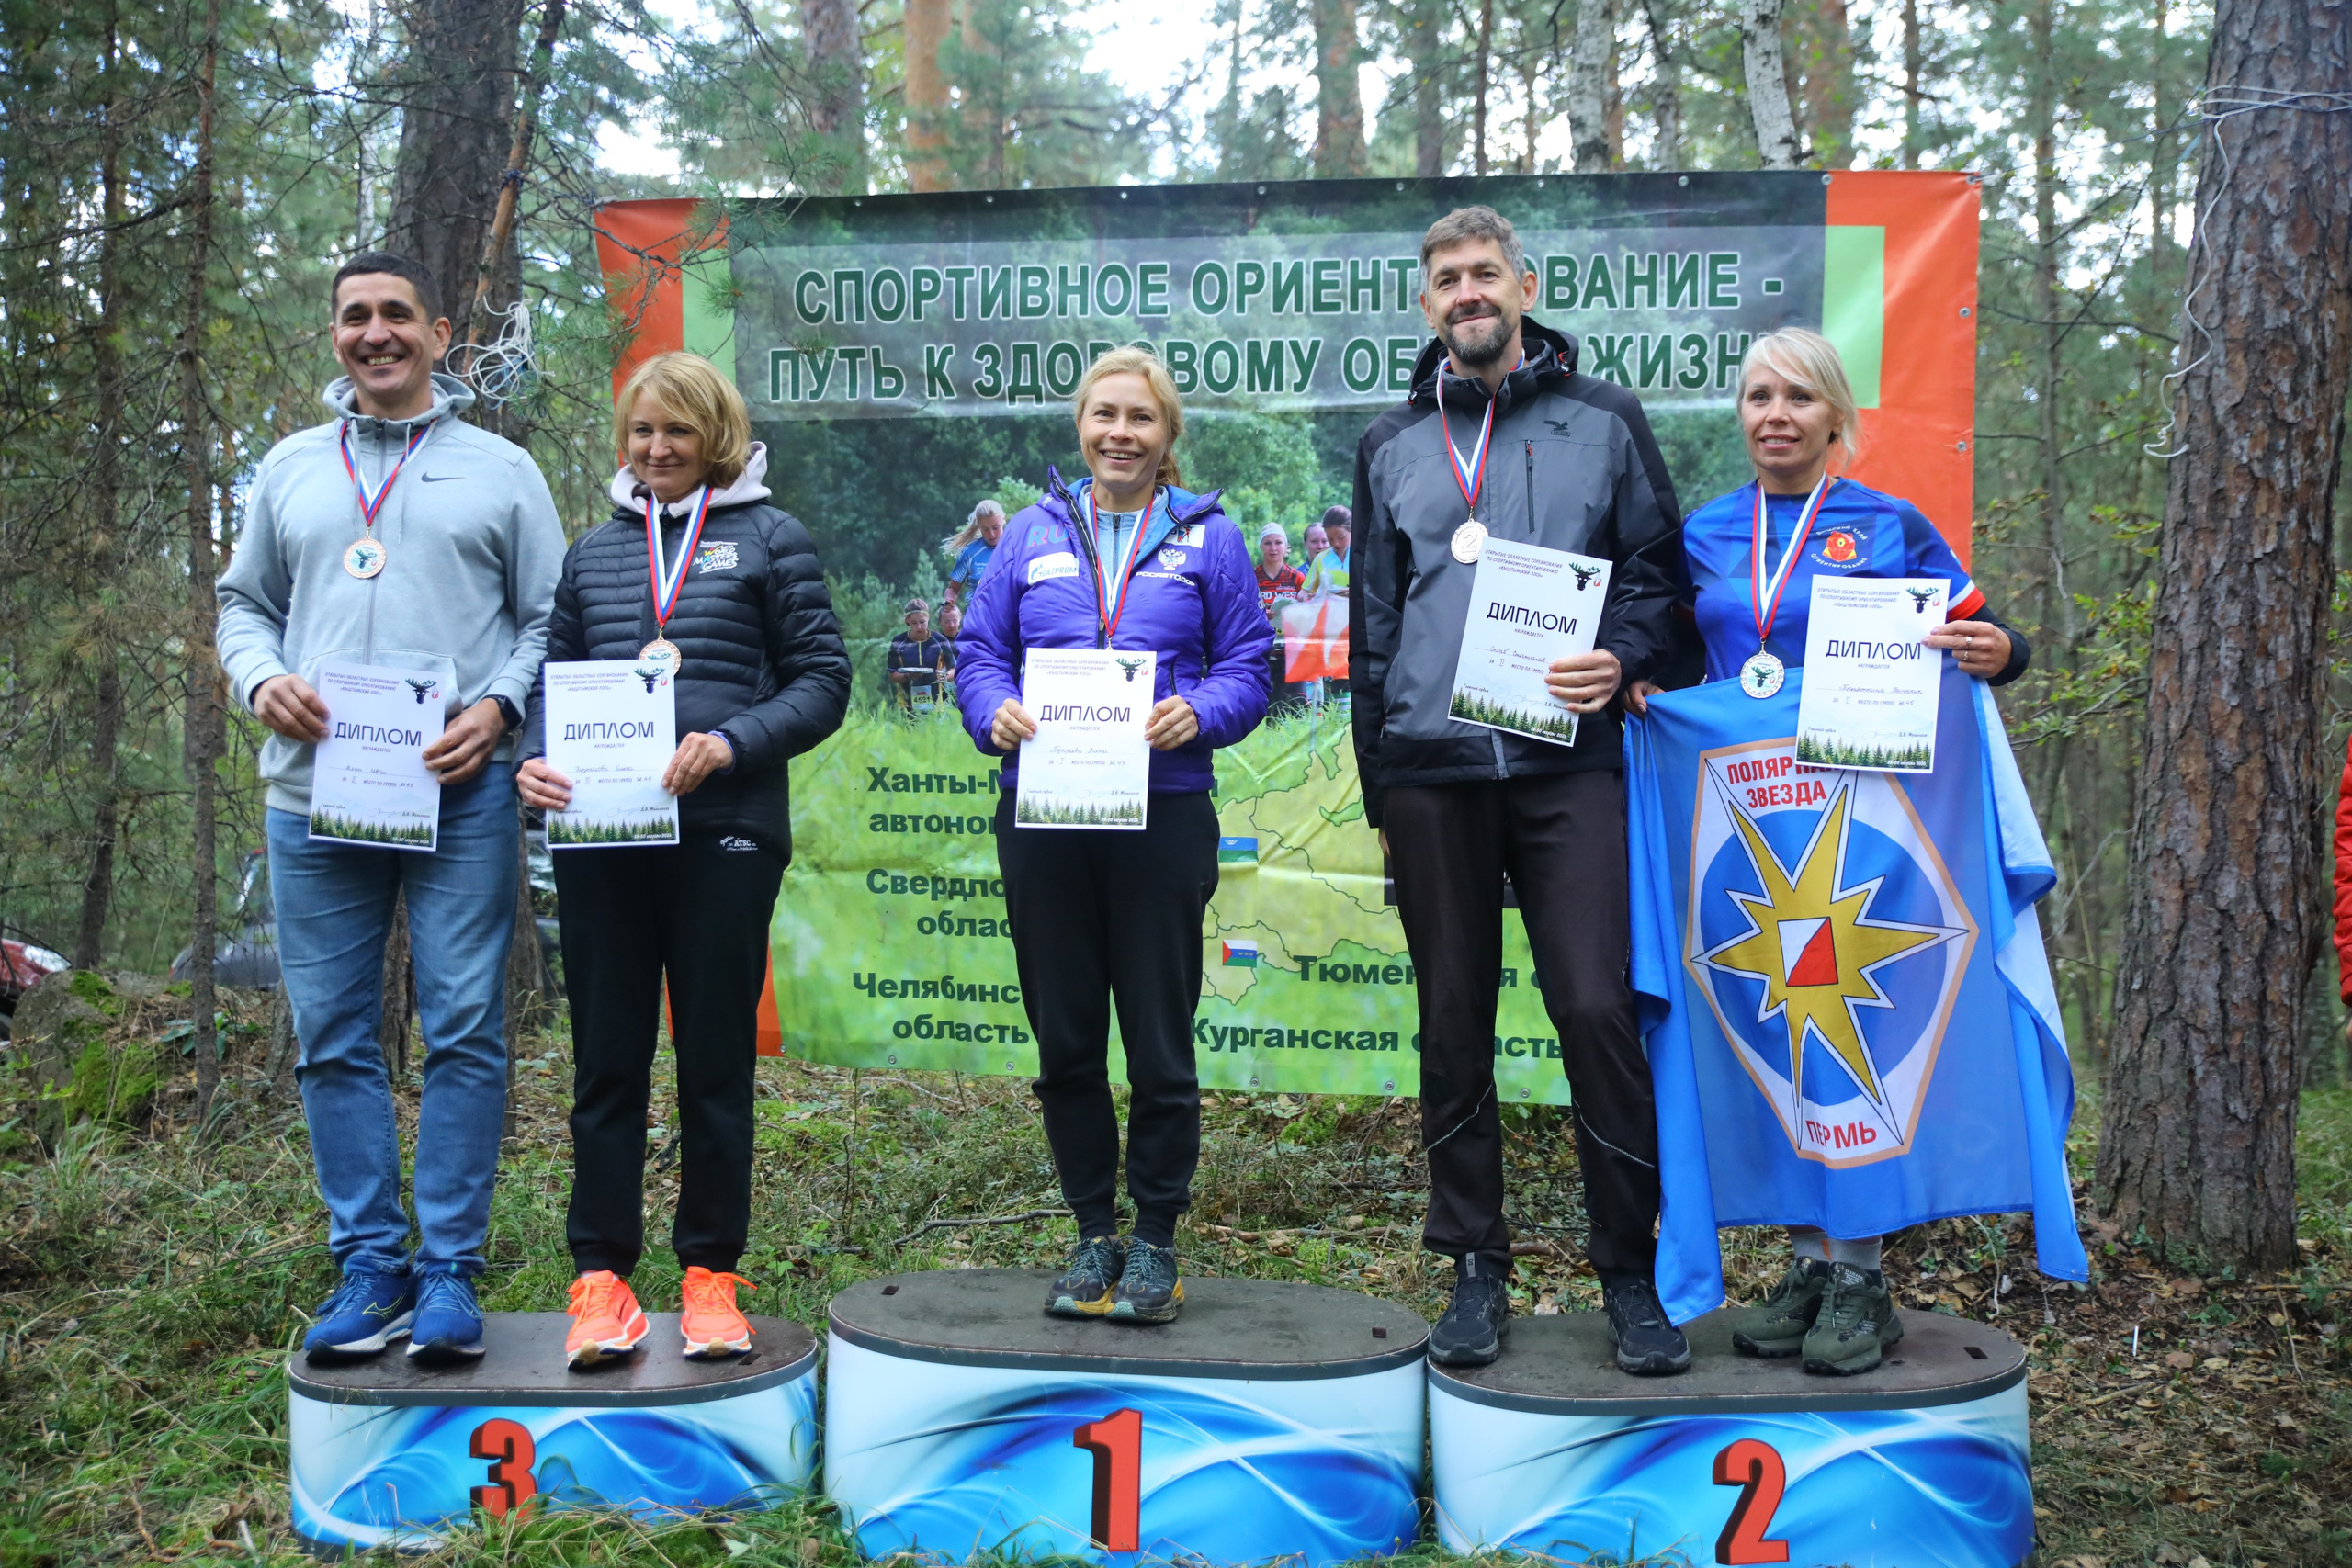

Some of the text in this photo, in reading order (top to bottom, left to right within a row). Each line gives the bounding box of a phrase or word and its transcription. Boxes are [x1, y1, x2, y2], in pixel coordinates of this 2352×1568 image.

[794, 261, 1170, 325] СПОРТИВНОЕ
[1191, 252, 1741, 316] ОРИЕНТВАНИЕ
[769, 344, 905, 402] ПУТЬ
[924, 344, 956, 400] К
[973, 338, 1323, 407] ЗДОВОМУ
[1586, 331, 1769, 390] ЖИЗН
[1486, 602, 1577, 636] ДИПЛОМ
[1514, 628, 1544, 638] НАГРАЖДАЕТСЯ
[1826, 639, 1921, 660] ДИПЛОМ
[1040, 705, 1130, 722] ДИПЛОМ
[335, 721, 422, 747] ДИПЛОМ
[564, 721, 654, 741] ДИПЛОМ
[1726, 756, 1840, 784] ПОЛЯР
[1746, 780, 1827, 808] ЗВЕЗДА
[866, 868, 1006, 902] Свердло
[917, 910, 1012, 938] облас
[853, 972, 1024, 1005] Челябинс
[892, 1013, 1030, 1044] область
[1192, 1018, 1398, 1054] Курганская
[1805, 1120, 1877, 1149] ПЕРМЬ
[469, 1417, 537, 1523] 3
[1073, 1407, 1143, 1552] 1
[1713, 1438, 1790, 1566] 2
